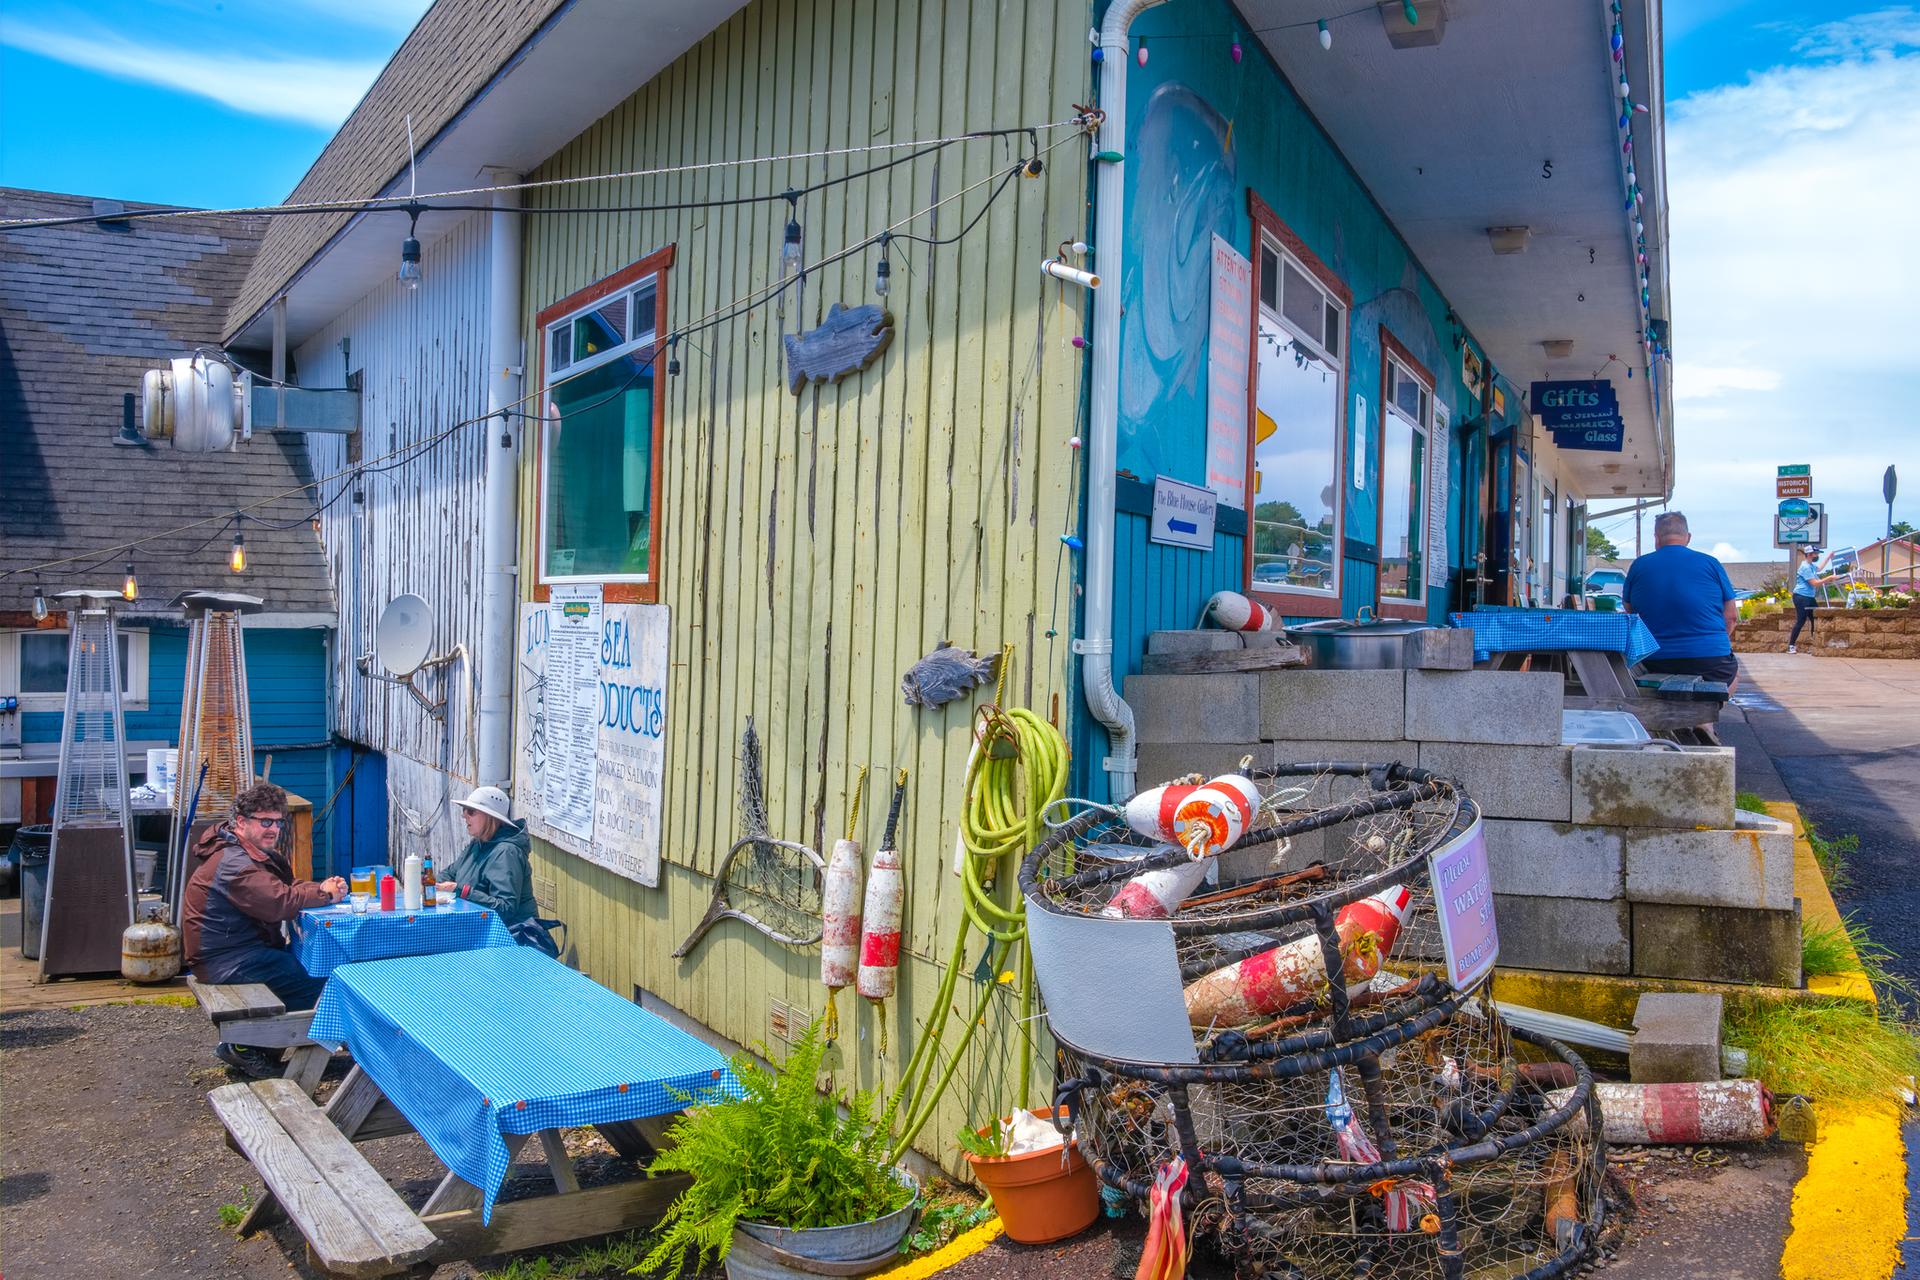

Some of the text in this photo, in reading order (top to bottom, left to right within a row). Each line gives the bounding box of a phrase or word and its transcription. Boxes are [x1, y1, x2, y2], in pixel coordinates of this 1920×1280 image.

[1542, 388, 1600, 407] Gifts
[1584, 431, 1617, 442] Glass
[1157, 490, 1214, 519] The Blue House Gallery
[527, 610, 550, 654] LUN
[602, 618, 631, 668] SEA
[599, 758, 625, 780] SMOKED
[626, 765, 657, 789] SALMON
[1453, 873, 1489, 916] WATCH
[1458, 943, 1482, 972] BUMP
